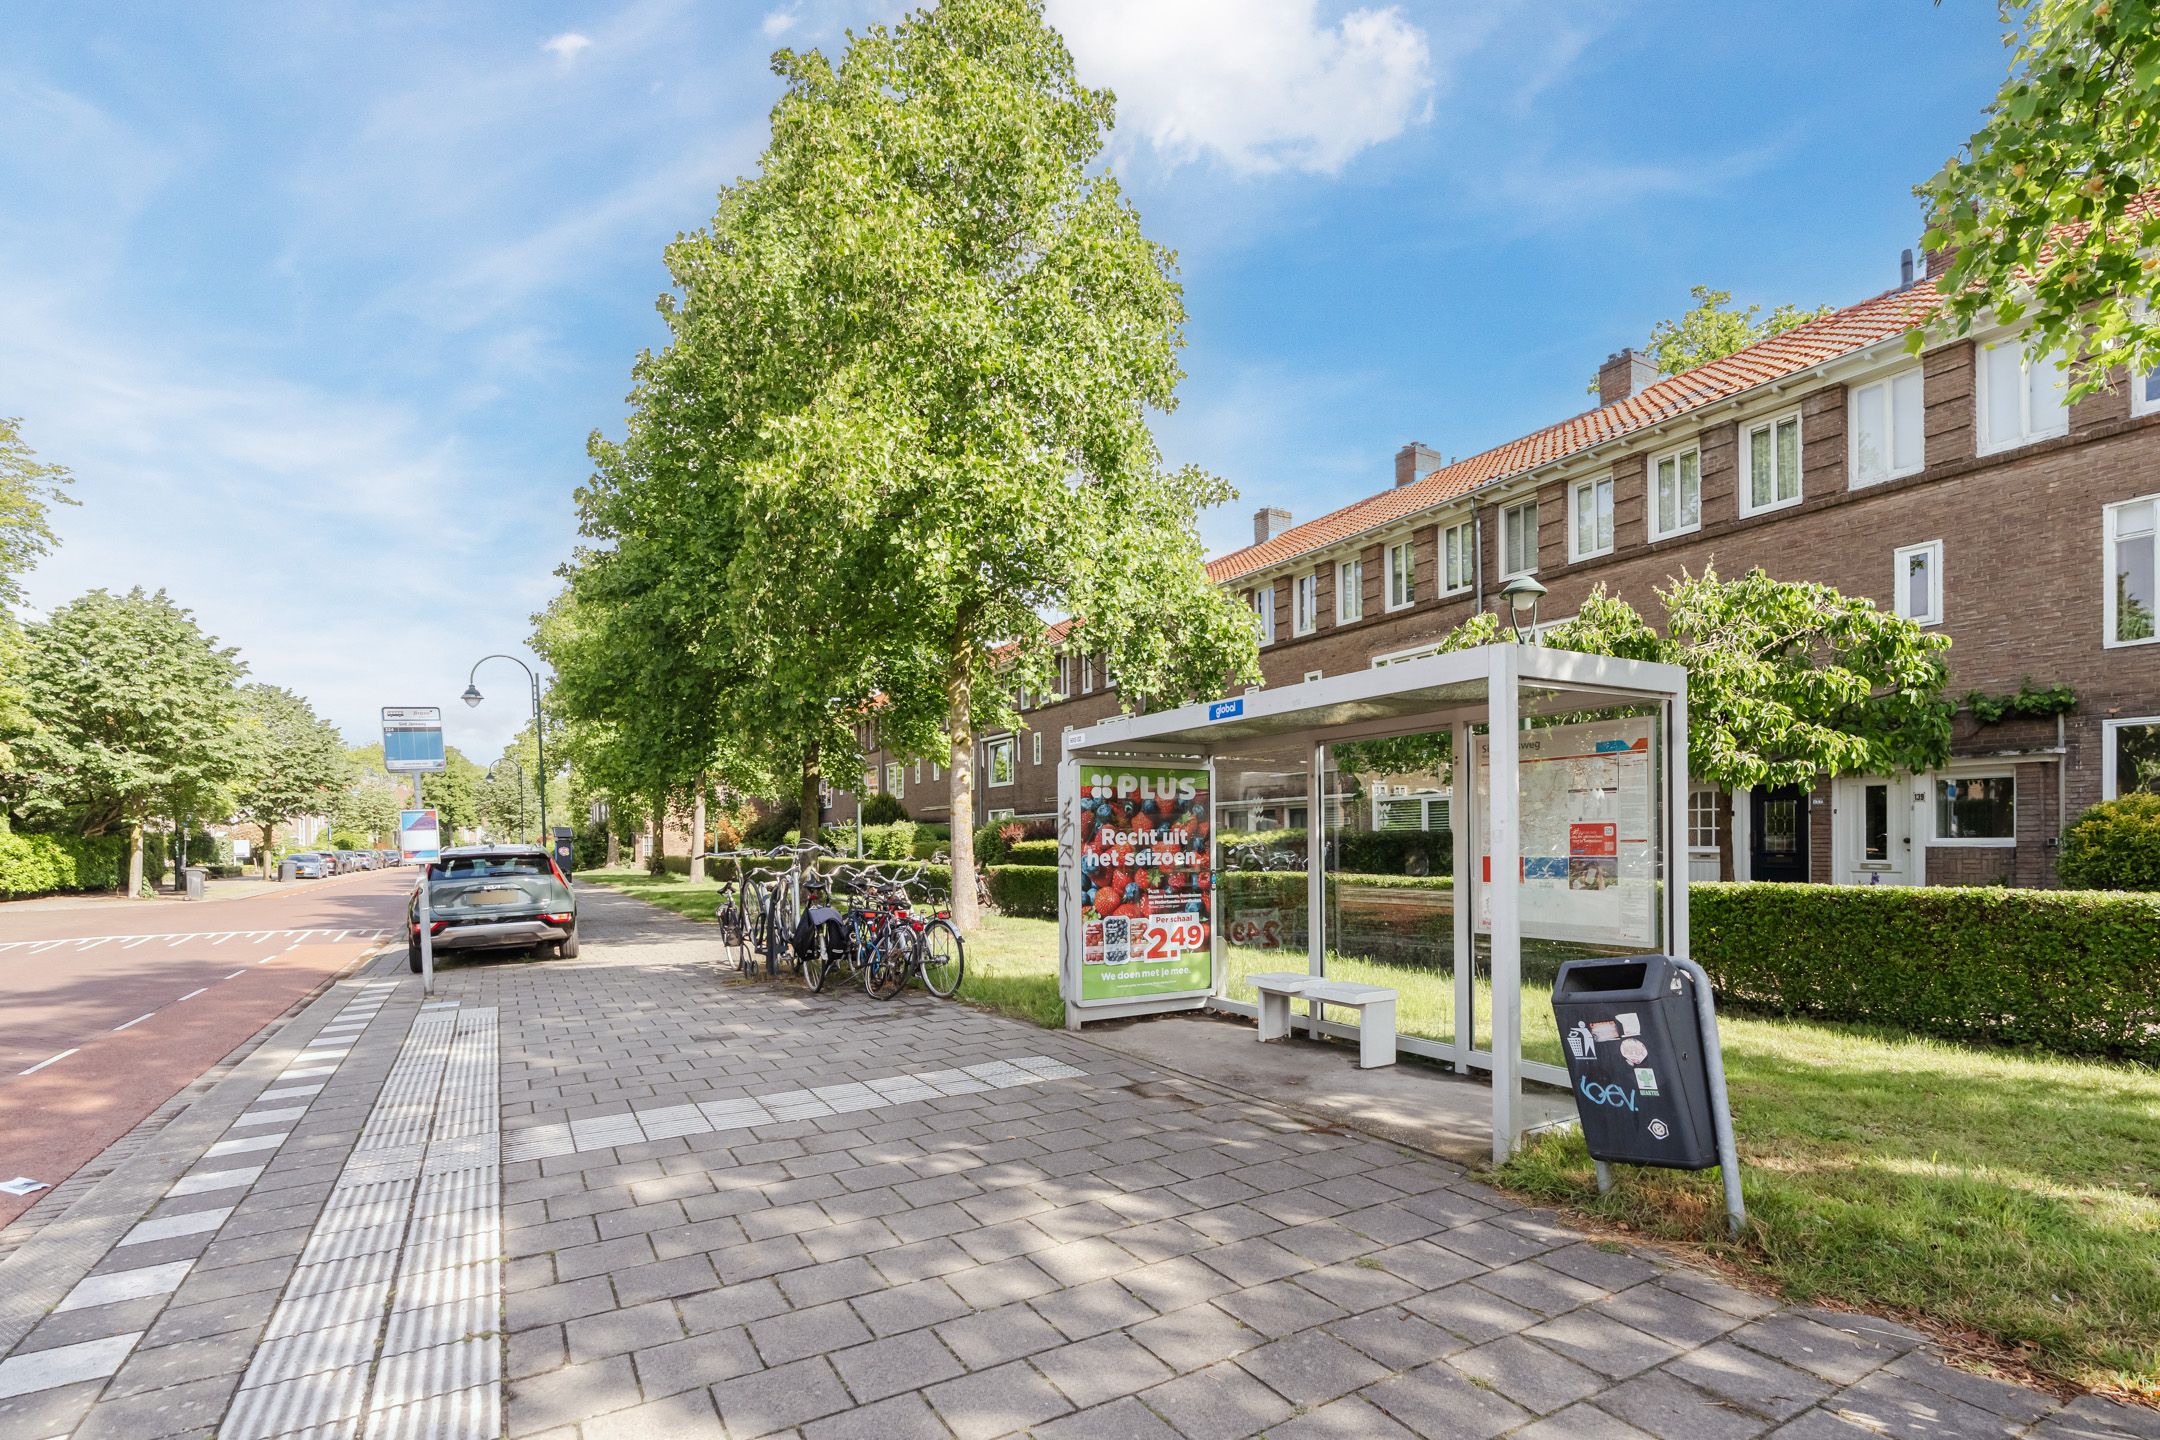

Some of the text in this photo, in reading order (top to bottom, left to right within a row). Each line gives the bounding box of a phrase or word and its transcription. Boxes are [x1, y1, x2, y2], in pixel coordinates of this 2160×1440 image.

[1216, 701, 1236, 718] global
[1117, 774, 1196, 801] PLUS
[1914, 793, 1925, 801] 139
[1101, 828, 1188, 846] Recht uit
[1087, 848, 1201, 867] het seizoen.
[1147, 925, 1202, 959] 2.49
[1101, 967, 1192, 981] We doen met je mee.
